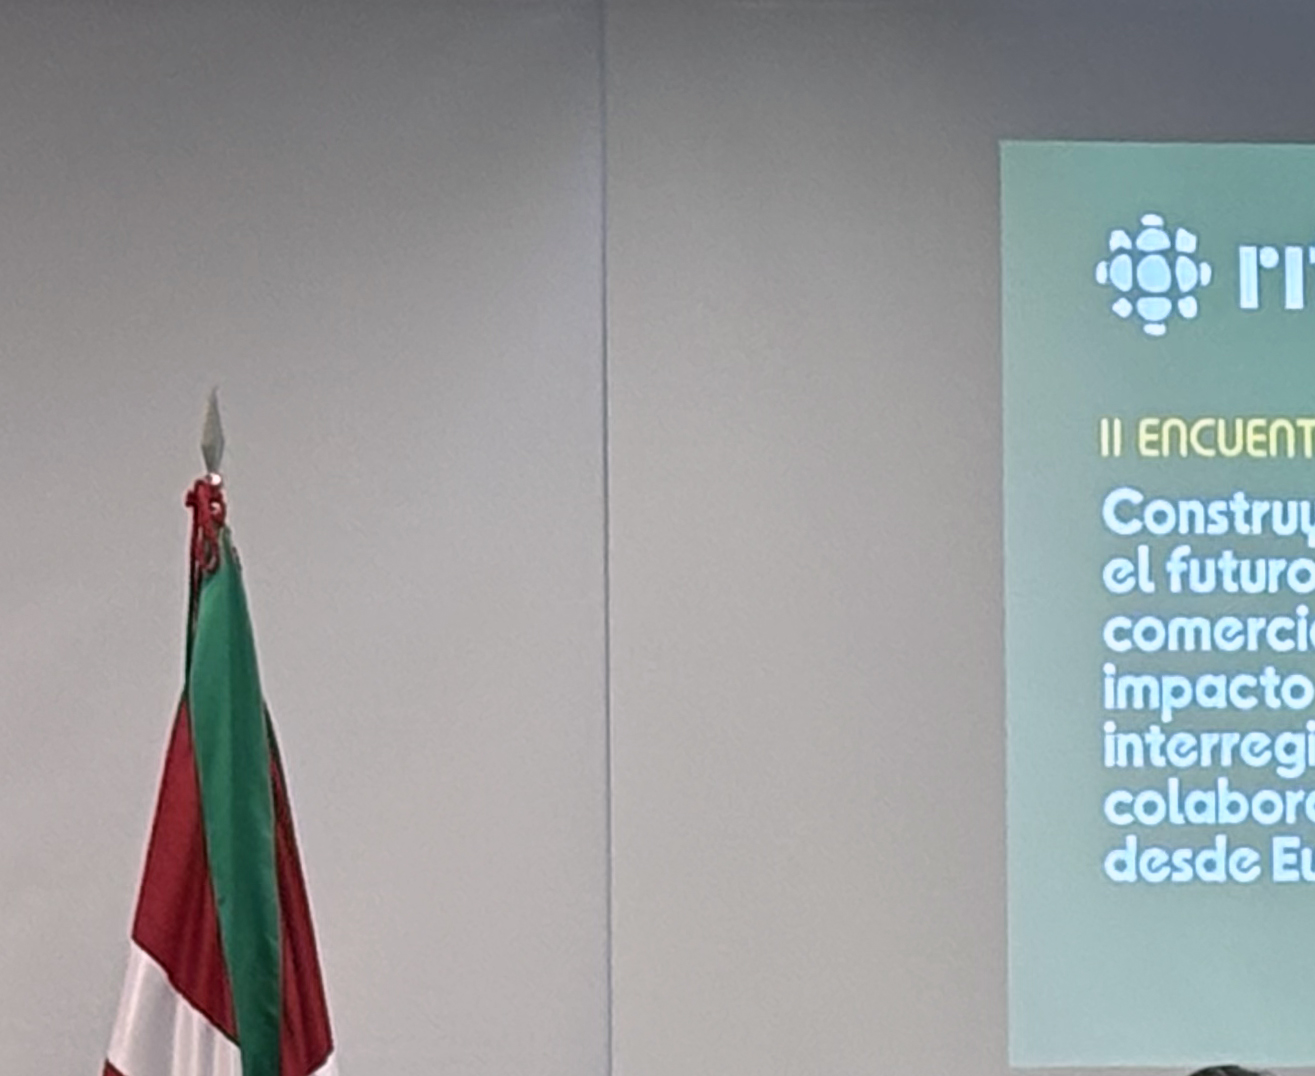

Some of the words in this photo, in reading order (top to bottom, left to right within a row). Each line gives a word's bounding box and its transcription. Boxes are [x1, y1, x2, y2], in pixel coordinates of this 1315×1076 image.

[1101, 418, 1121, 456] II
[1102, 545, 1155, 593] el
[1103, 663, 1315, 723] impacto
[1104, 834, 1262, 882] desde
